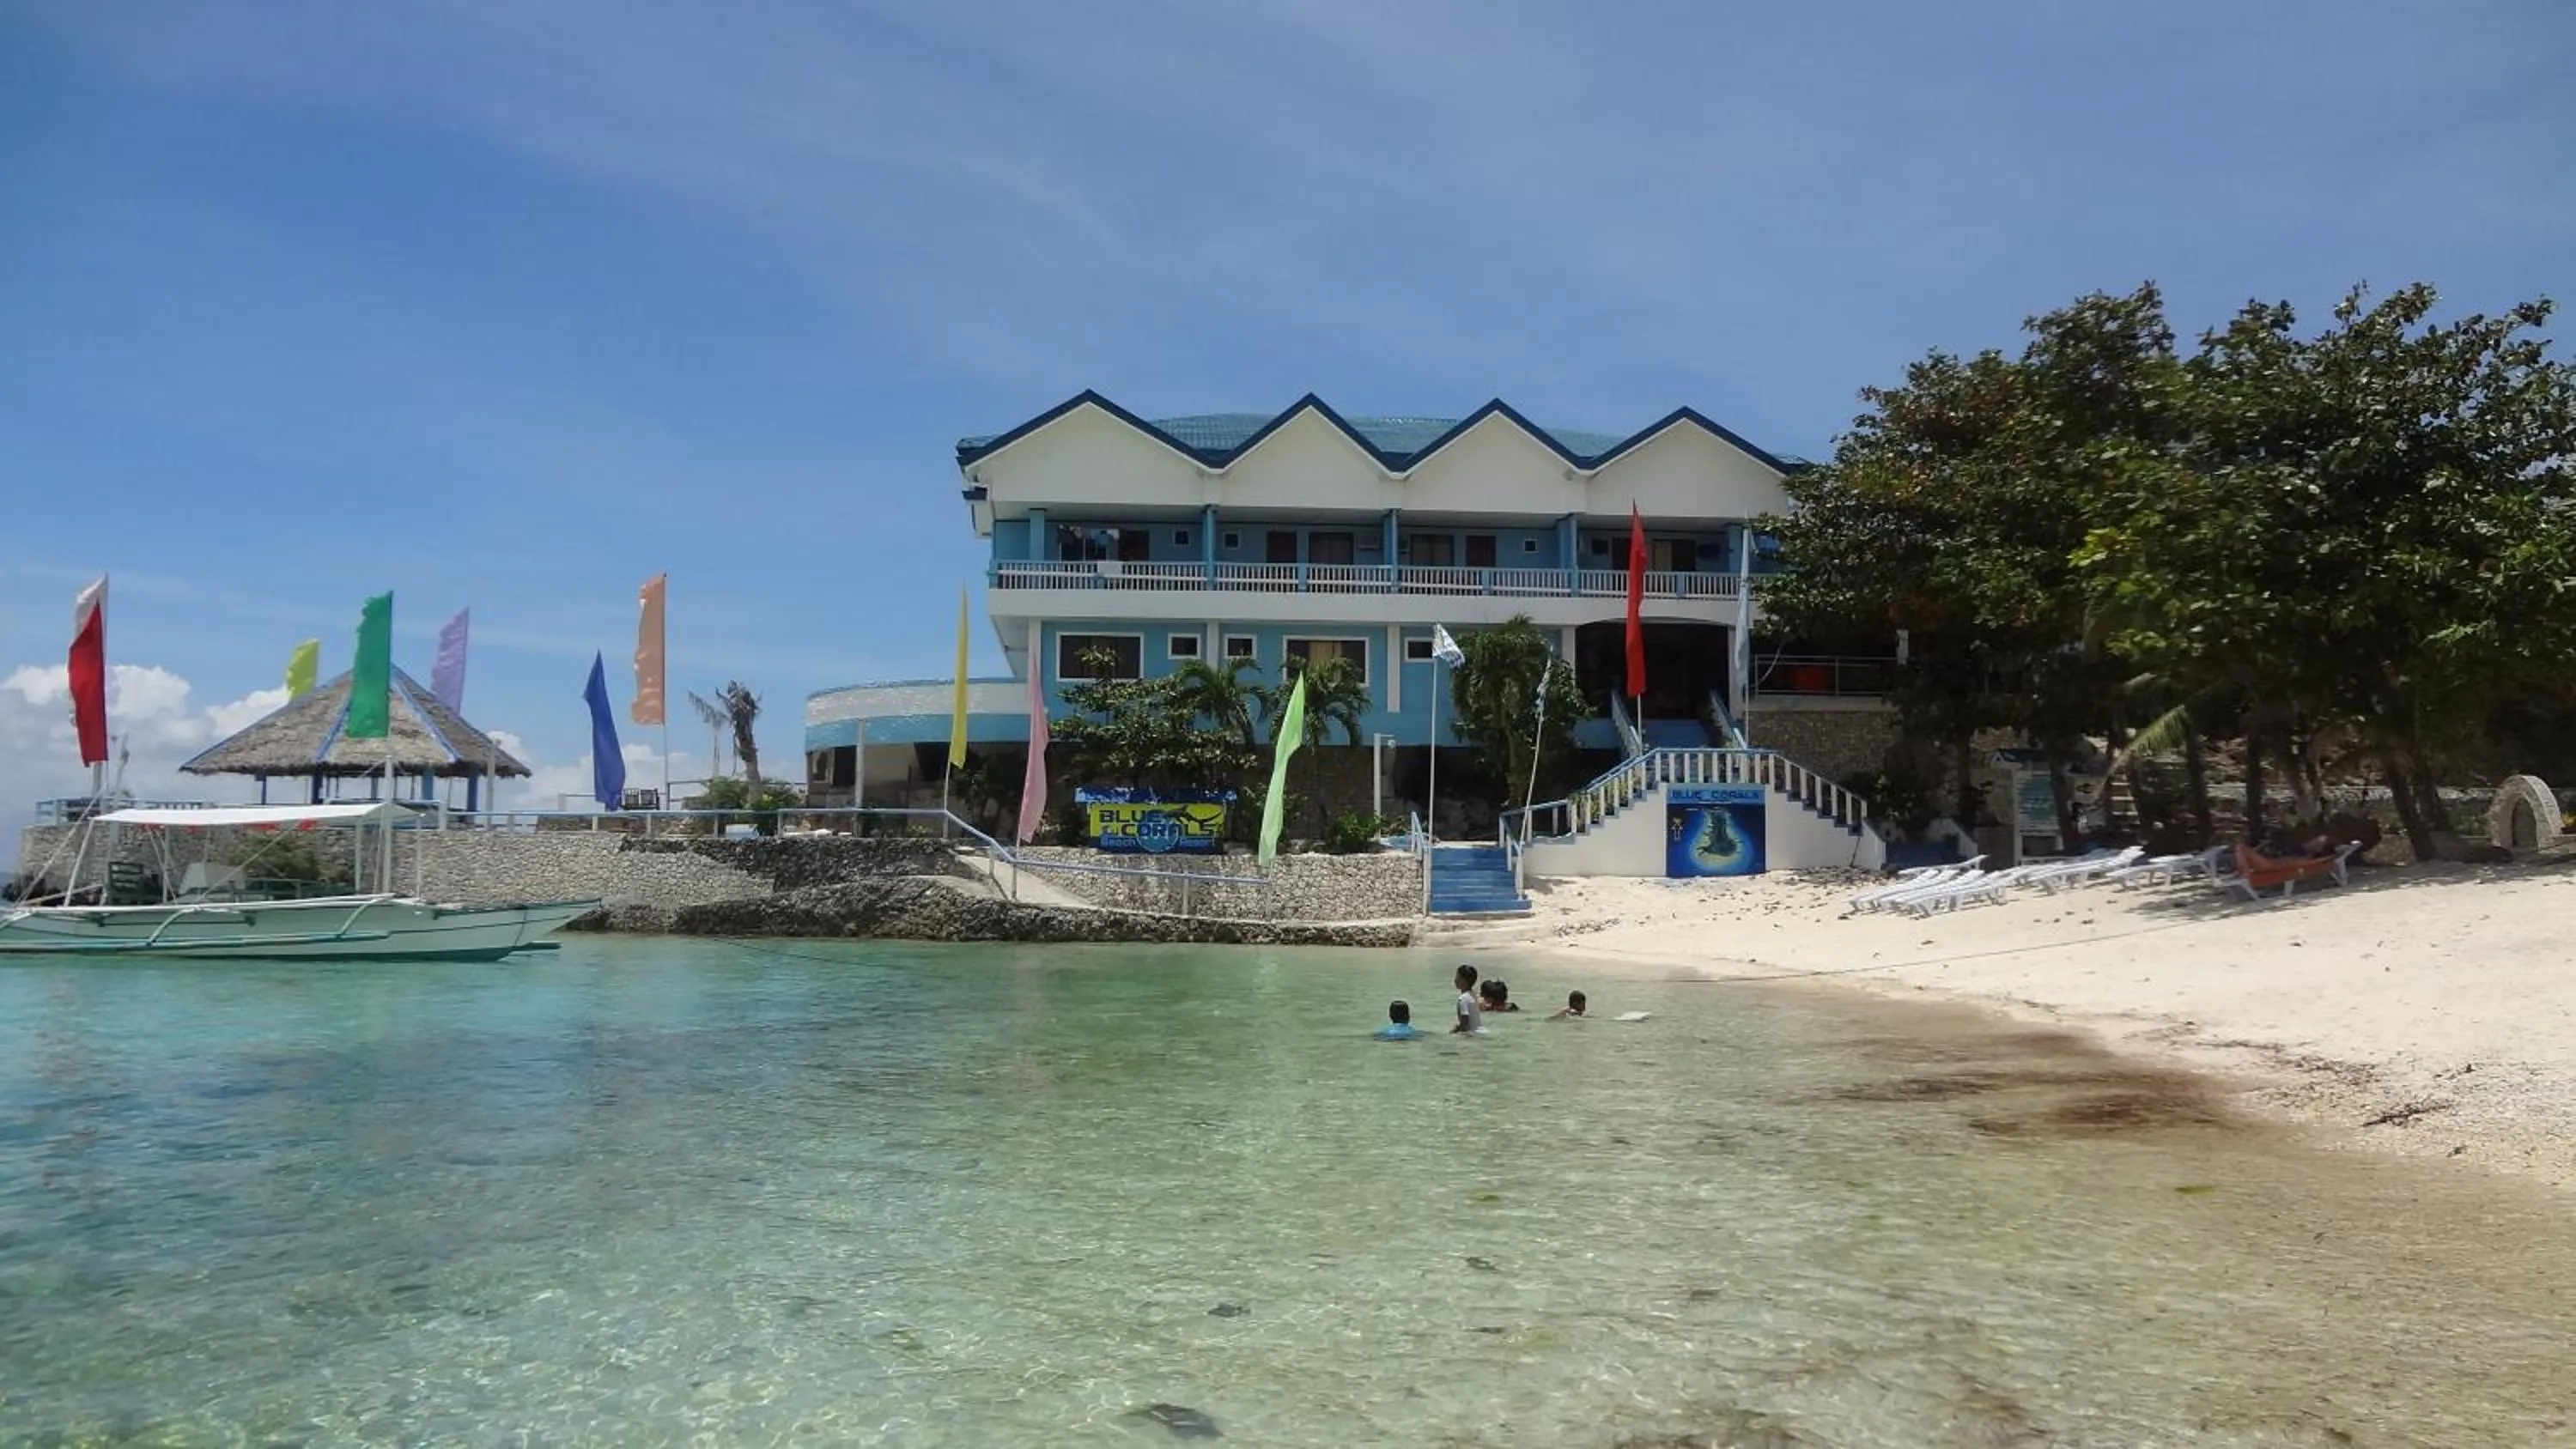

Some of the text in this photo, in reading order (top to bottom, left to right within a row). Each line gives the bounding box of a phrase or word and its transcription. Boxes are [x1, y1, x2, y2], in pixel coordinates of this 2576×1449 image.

[1672, 788, 1759, 800] BLUE CORALS
[1099, 809, 1214, 837] BLUE CORALS
